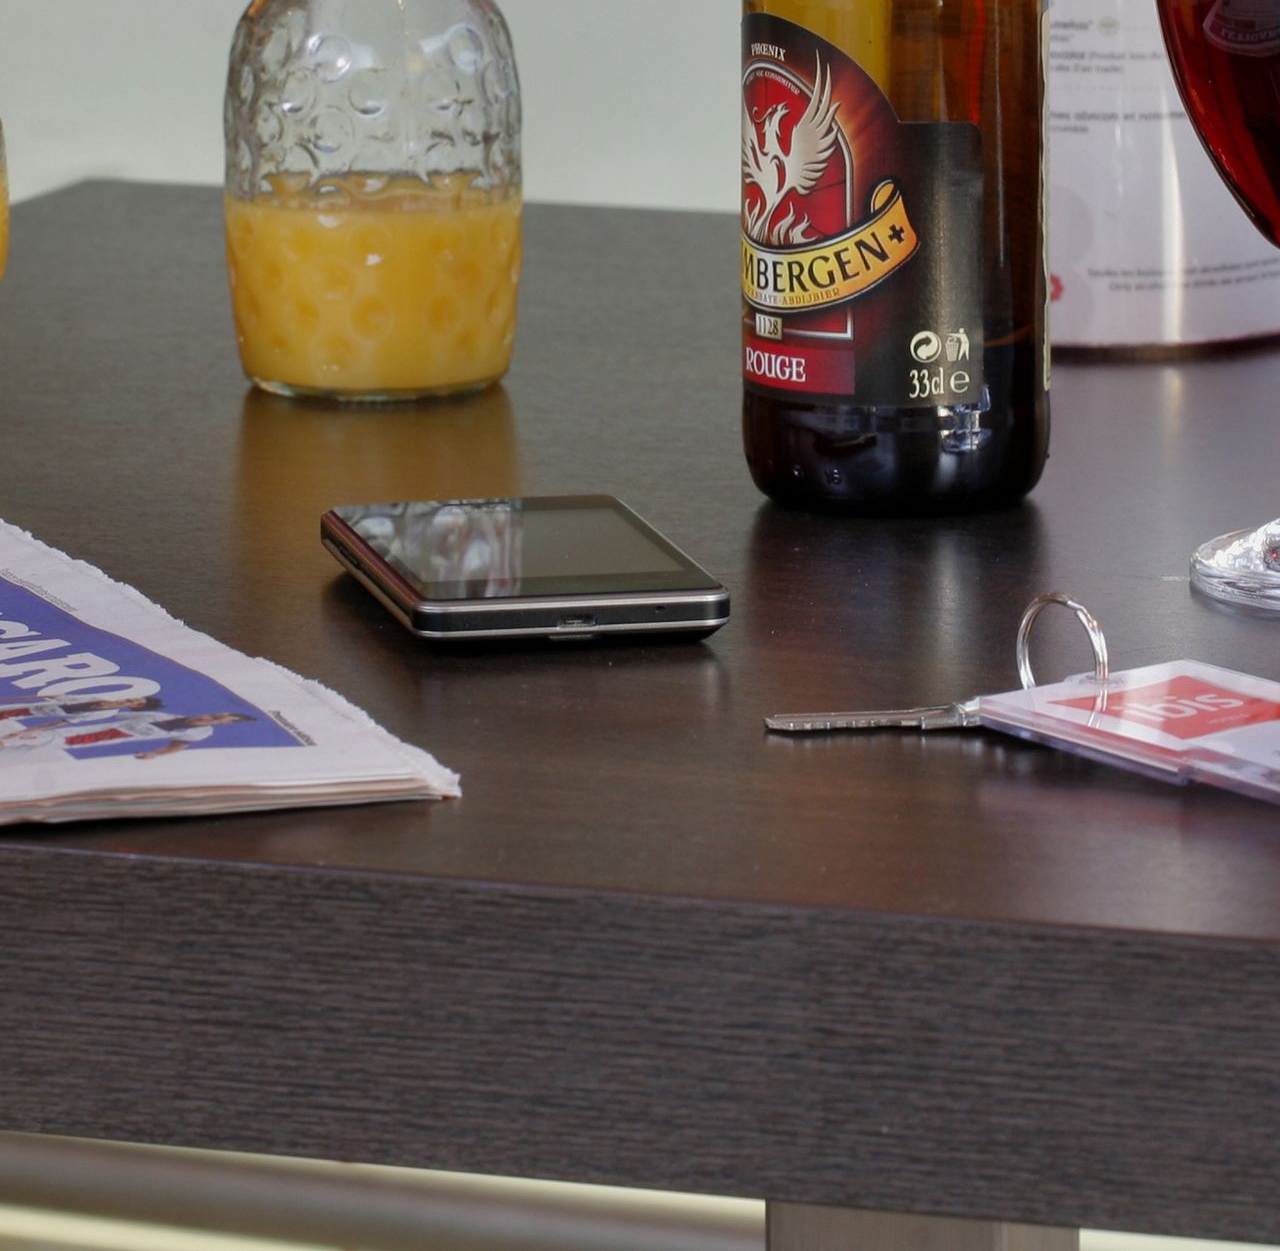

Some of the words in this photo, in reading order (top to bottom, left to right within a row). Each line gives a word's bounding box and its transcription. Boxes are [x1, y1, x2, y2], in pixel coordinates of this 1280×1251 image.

[742, 231, 890, 294] MBERGEN
[757, 316, 780, 337] 1128
[746, 347, 807, 383] ROUGE
[909, 367, 945, 399] 33cl
[1112, 693, 1244, 723] ibis
